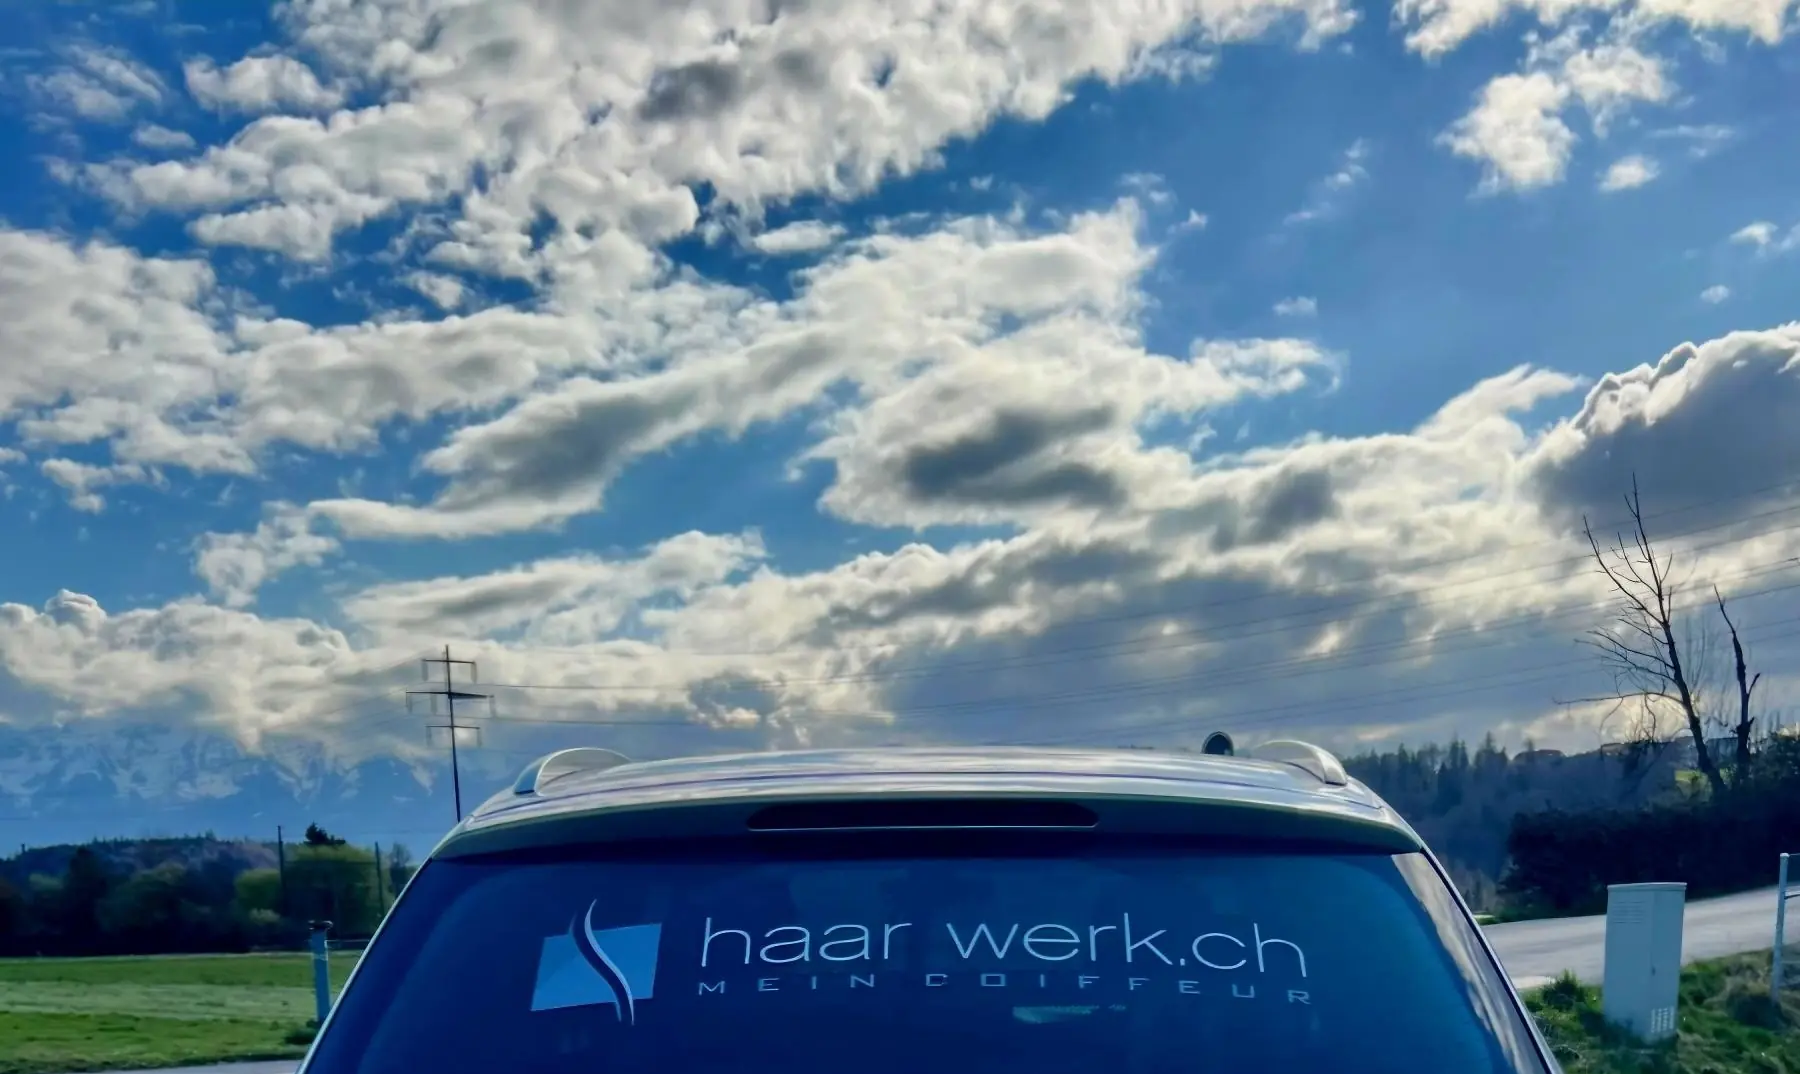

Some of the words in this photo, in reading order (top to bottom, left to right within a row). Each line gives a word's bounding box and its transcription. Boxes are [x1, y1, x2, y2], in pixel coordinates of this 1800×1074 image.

[701, 917, 912, 967] haar
[946, 913, 1306, 976] werk.ch
[699, 974, 875, 994] MEIN
[925, 973, 1312, 1005] COIFFEUR
